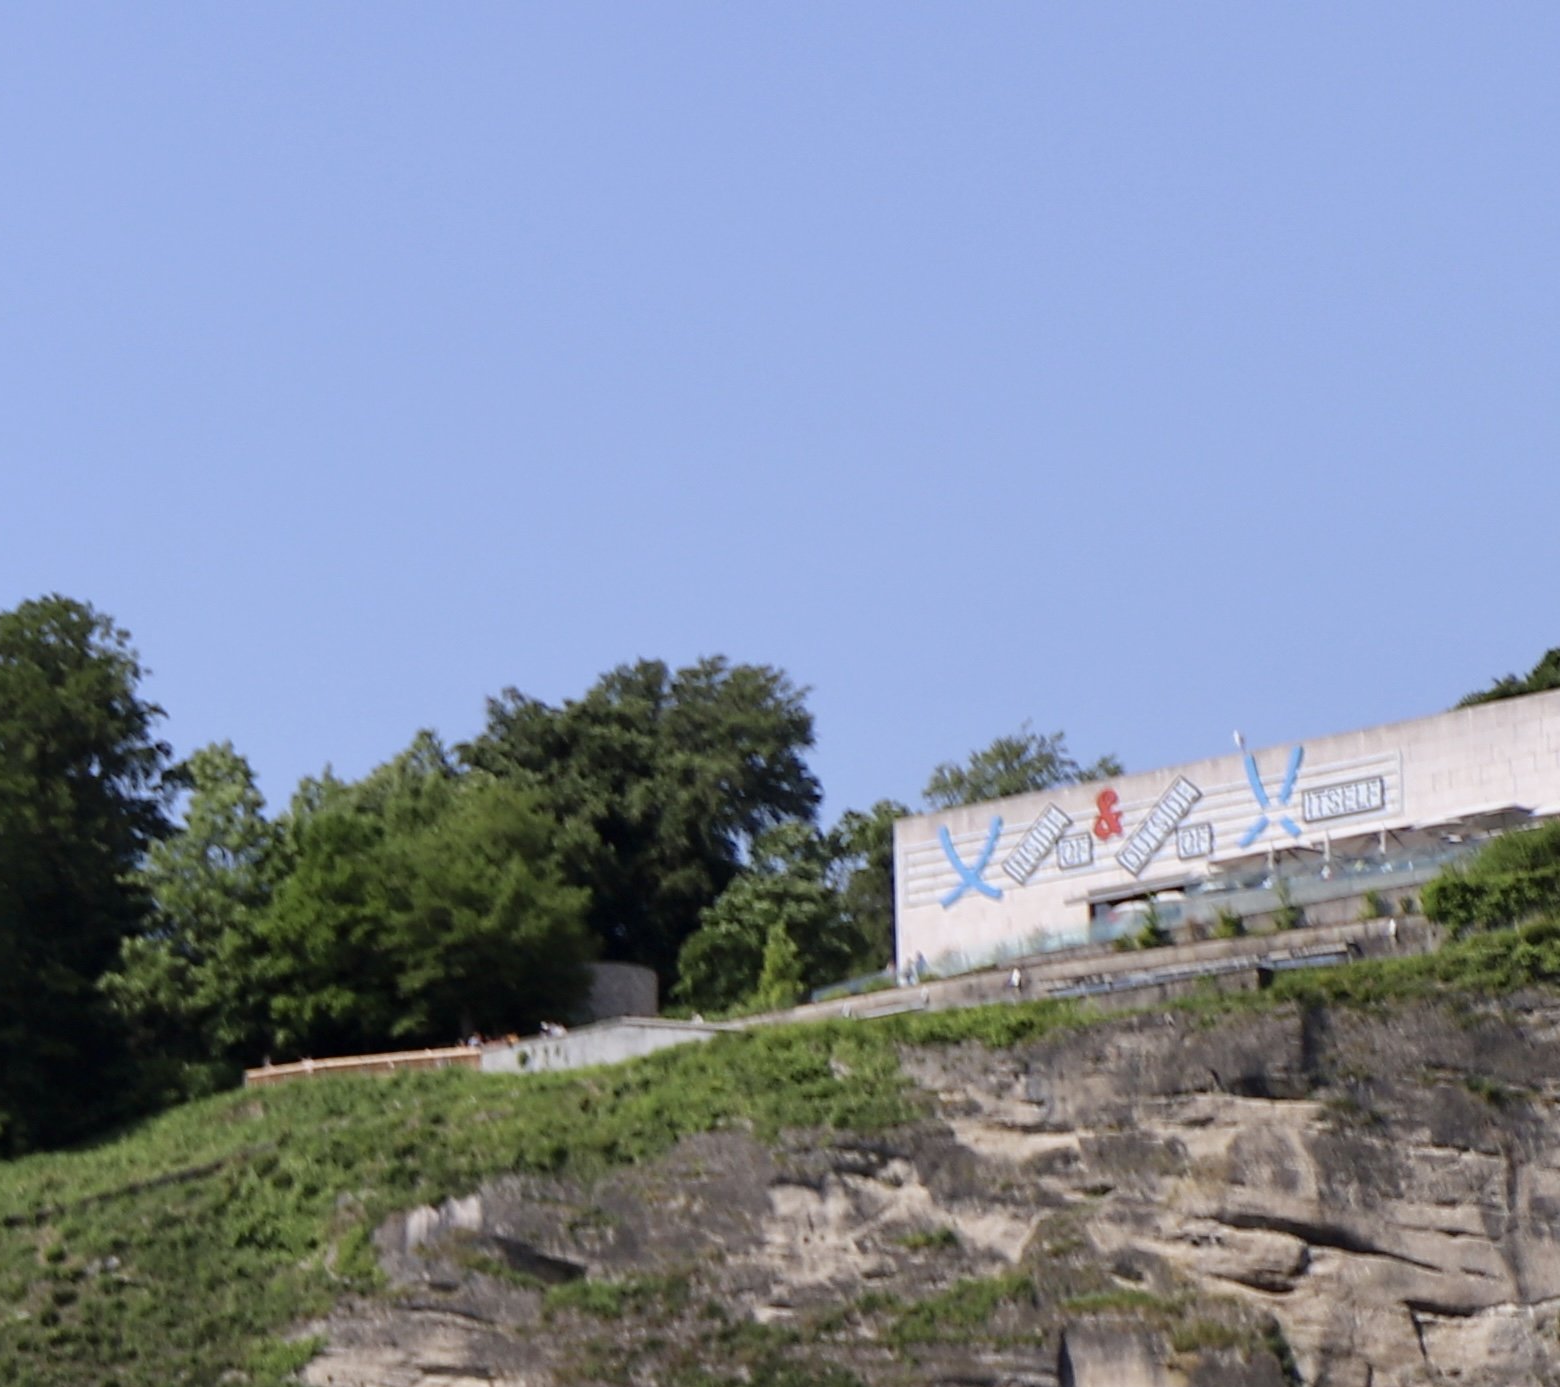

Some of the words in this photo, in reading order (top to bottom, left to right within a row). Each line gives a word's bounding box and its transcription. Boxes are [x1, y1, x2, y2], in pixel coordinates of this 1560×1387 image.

[1059, 836, 1091, 867] OF
[1119, 779, 1200, 873] OUTSIDE
[1178, 826, 1210, 857] OF
[1304, 779, 1383, 821] ITSELF
